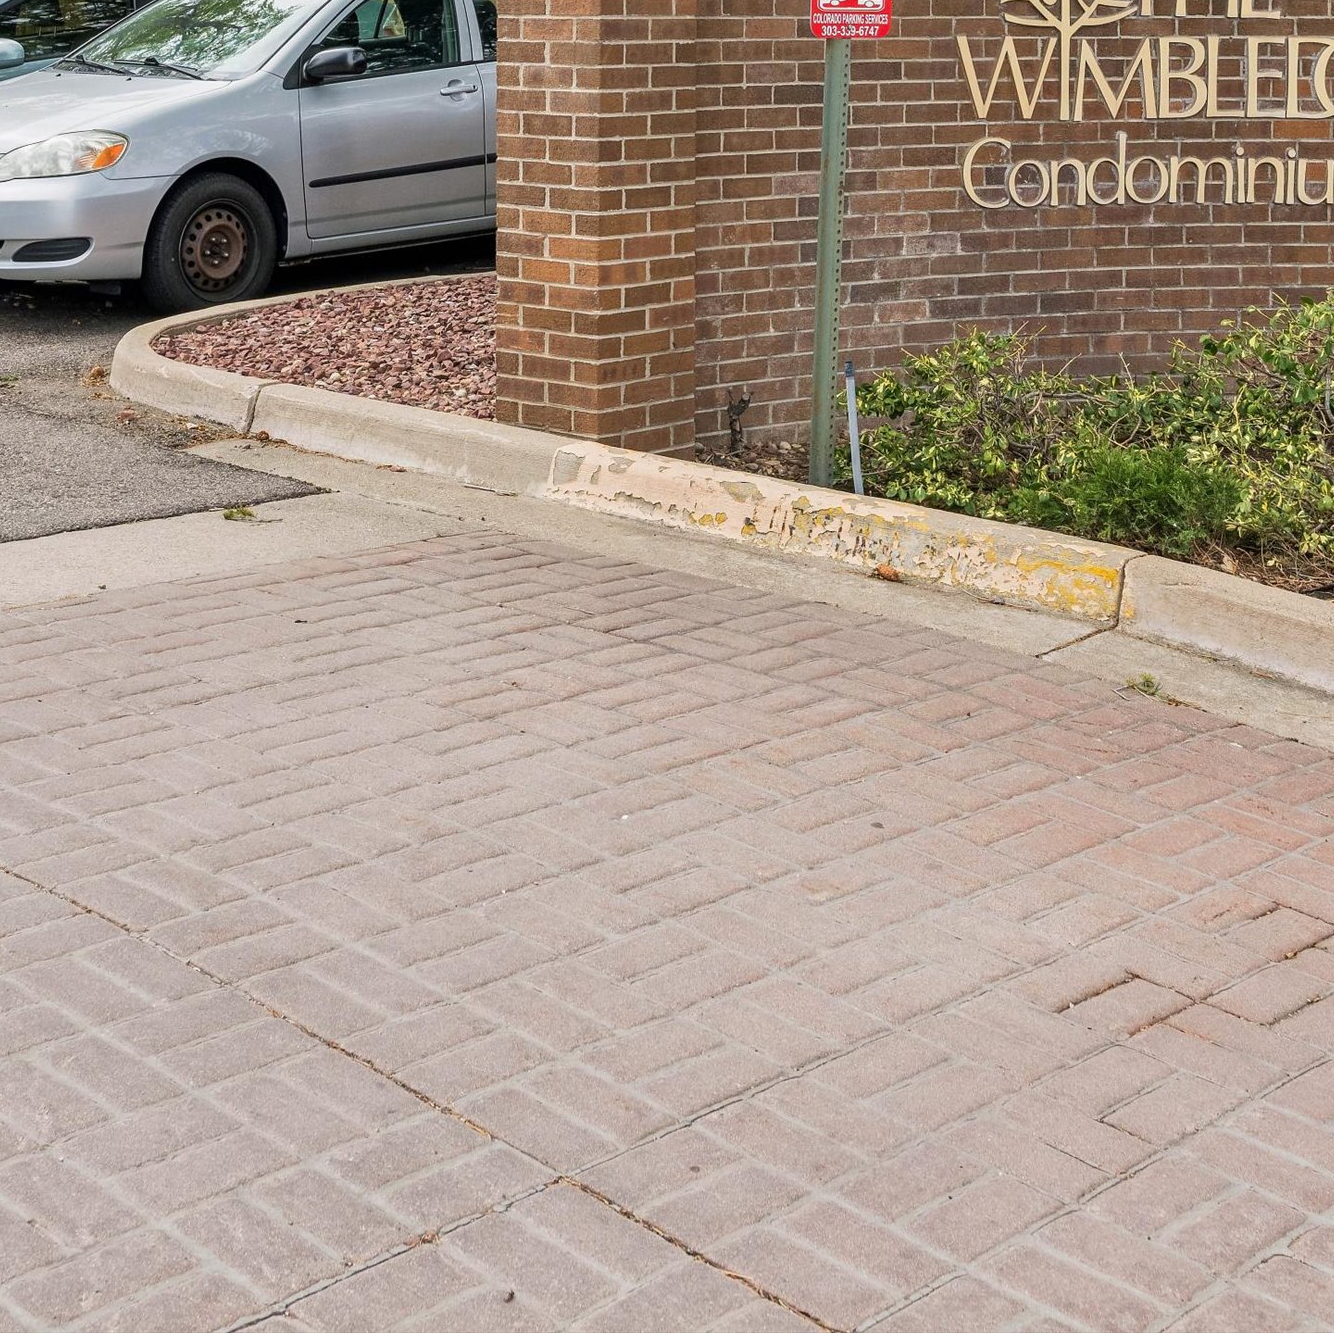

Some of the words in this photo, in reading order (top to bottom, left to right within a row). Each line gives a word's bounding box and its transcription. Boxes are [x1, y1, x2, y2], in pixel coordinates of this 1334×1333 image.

[813, 13, 842, 24] COLORADO
[843, 13, 864, 24] PARKING
[865, 14, 889, 25] SERVICES
